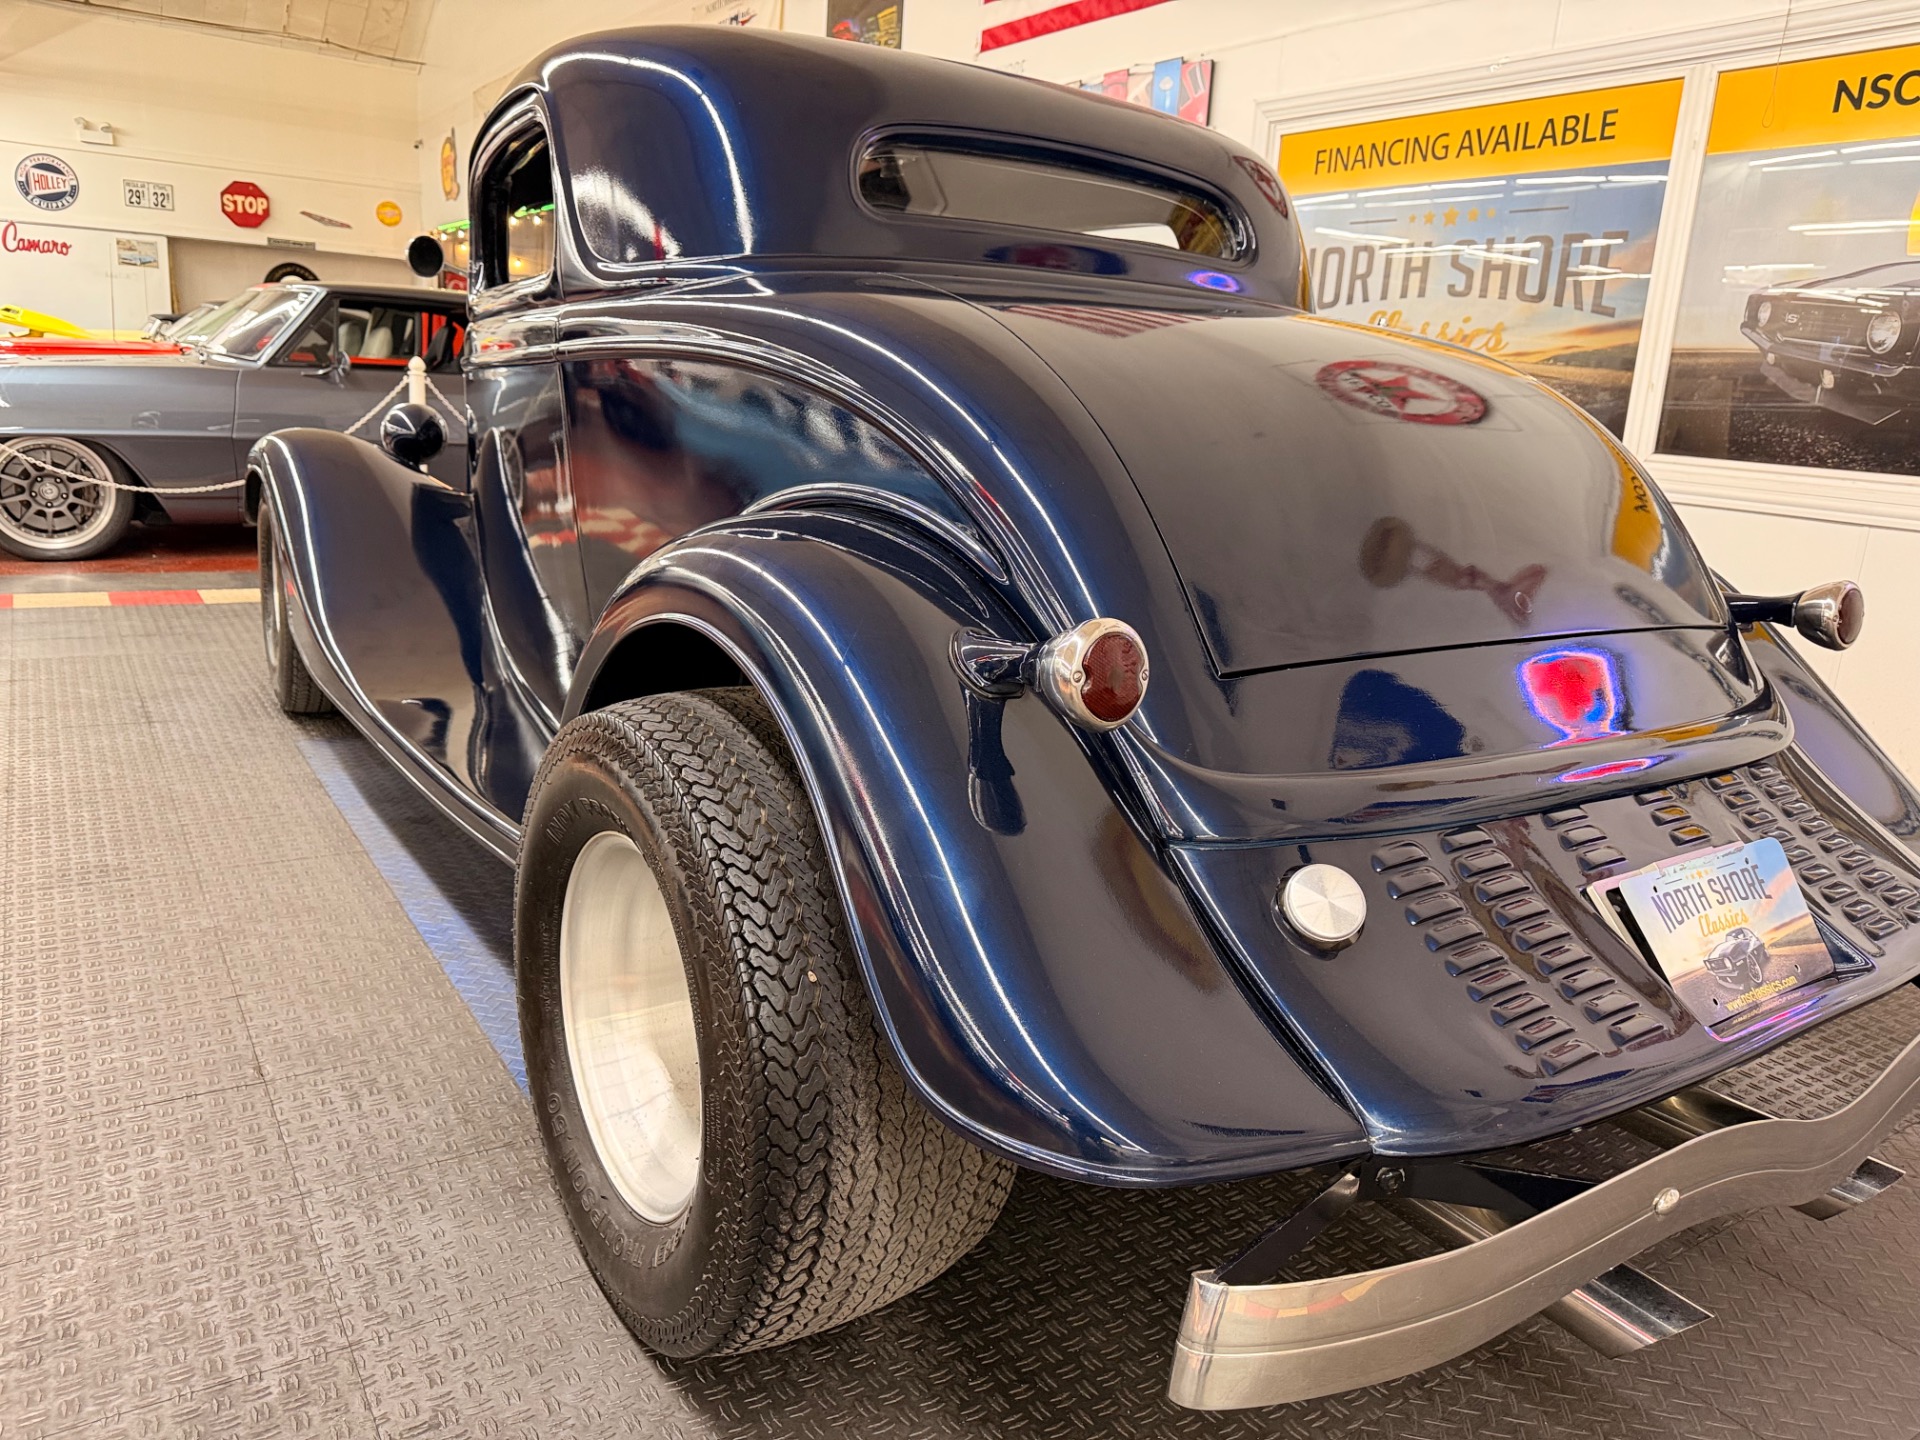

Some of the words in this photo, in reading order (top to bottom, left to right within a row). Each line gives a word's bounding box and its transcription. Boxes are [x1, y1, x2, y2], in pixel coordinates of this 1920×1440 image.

[1314, 132, 1450, 175] FINANCING
[1456, 108, 1619, 159] AVAILABLE
[32, 172, 67, 192] HOLLEY
[222, 193, 268, 215] STOP
[2, 220, 72, 256] Camaro
[1447, 230, 1630, 318] SHORE
[1651, 882, 1713, 933] NORTH
[1708, 864, 1773, 906] SHORE
[1698, 907, 1750, 938] Classics
[1725, 975, 1798, 1012] www.nsclassics.com
